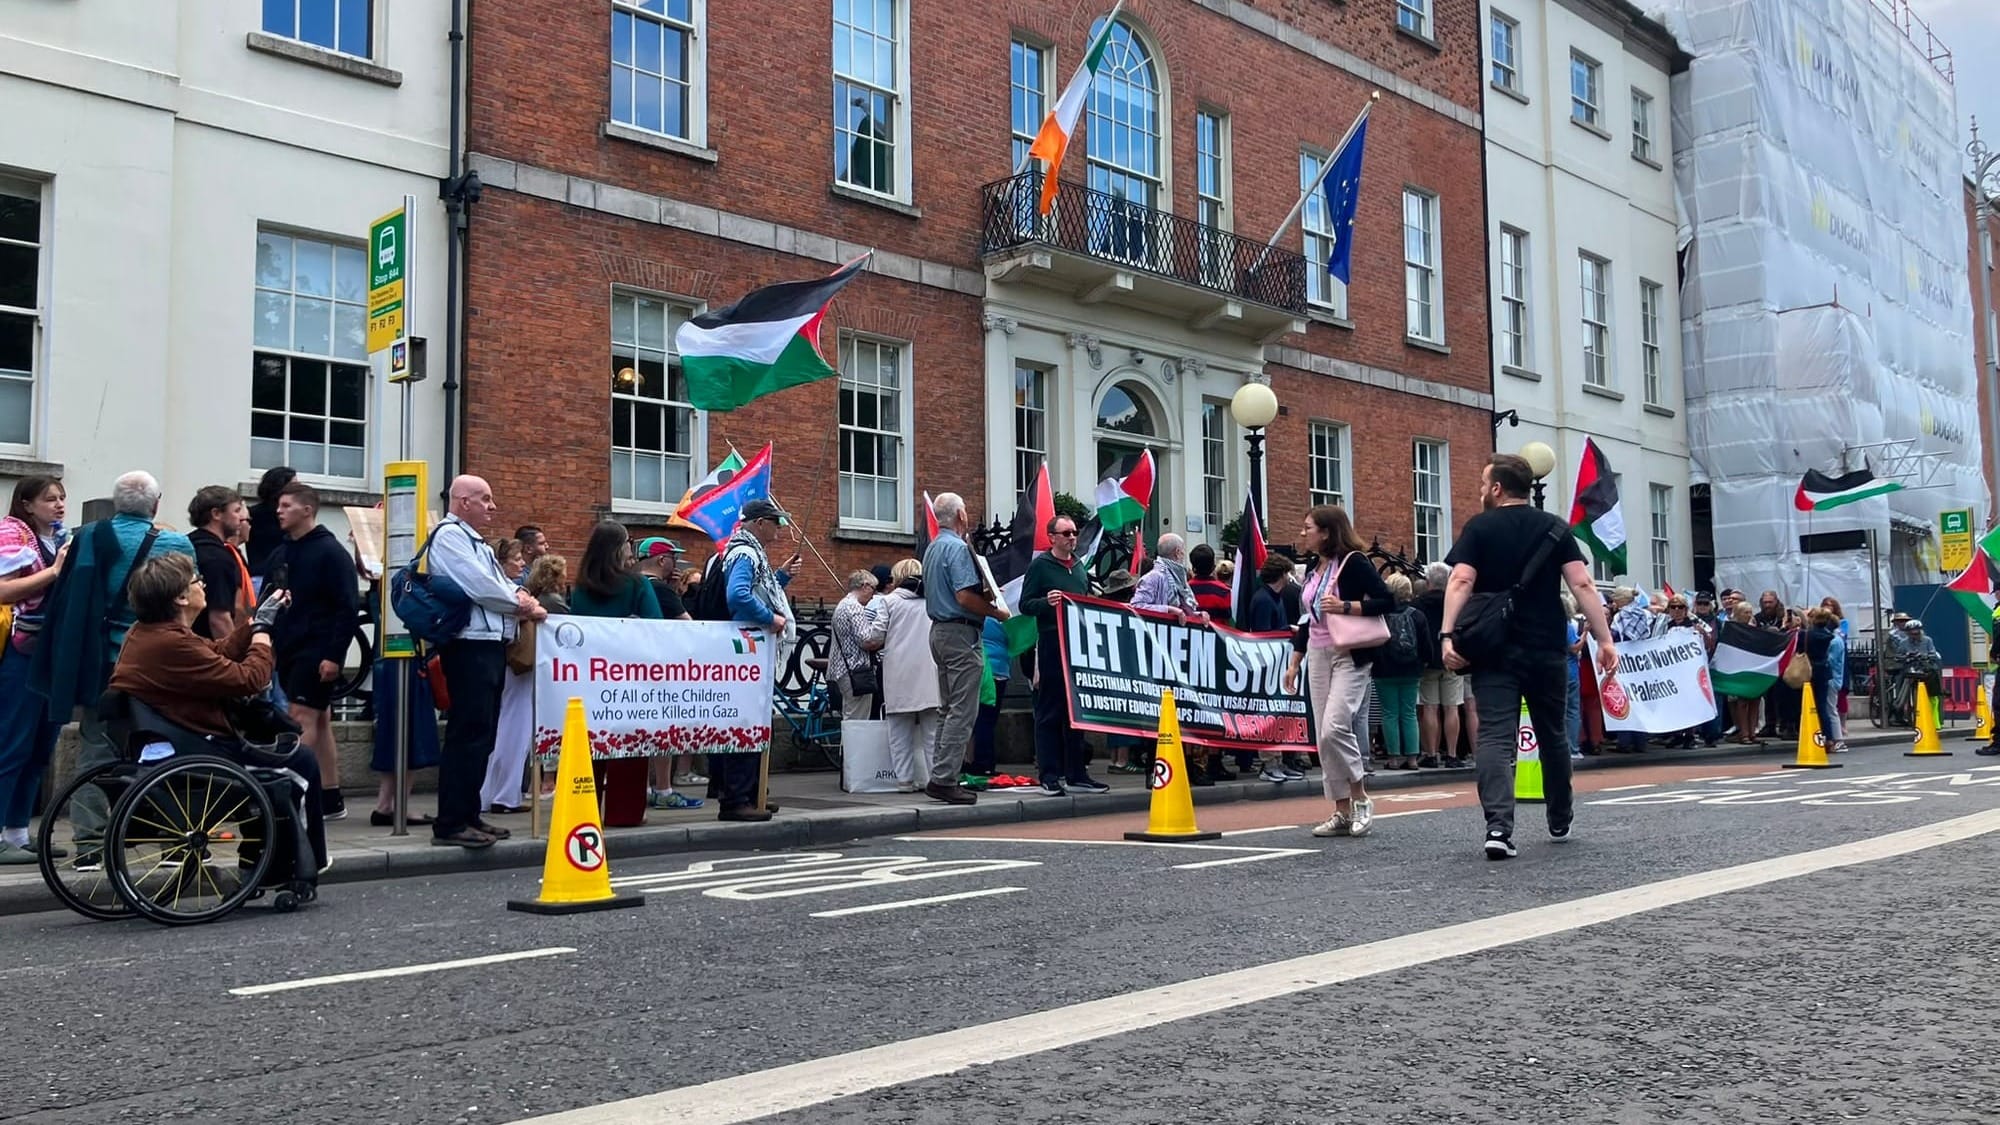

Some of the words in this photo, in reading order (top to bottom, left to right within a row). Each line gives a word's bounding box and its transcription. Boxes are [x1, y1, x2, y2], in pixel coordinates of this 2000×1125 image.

[1067, 604, 1122, 673] LET
[1129, 617, 1216, 689] THEM
[553, 657, 578, 682] In
[590, 656, 761, 682] Remembrance
[601, 689, 616, 703] Of
[621, 689, 638, 703] All
[641, 688, 655, 703] of
[658, 689, 679, 703] the
[682, 688, 730, 703] Children
[1075, 672, 1131, 692] PALESTINIAN
[1132, 680, 1171, 698] STUDENT
[1223, 695, 1248, 711] VISAS
[1247, 698, 1268, 712] AFTER
[592, 706, 623, 720] who
[627, 708, 658, 720] were
[662, 705, 696, 719] Killed
[699, 705, 710, 718] in
[712, 705, 738, 718] Gaza
[1079, 694, 1092, 708] TO
[1093, 695, 1127, 713] JUSTIFY
[1583, 789, 1960, 807] BUS
